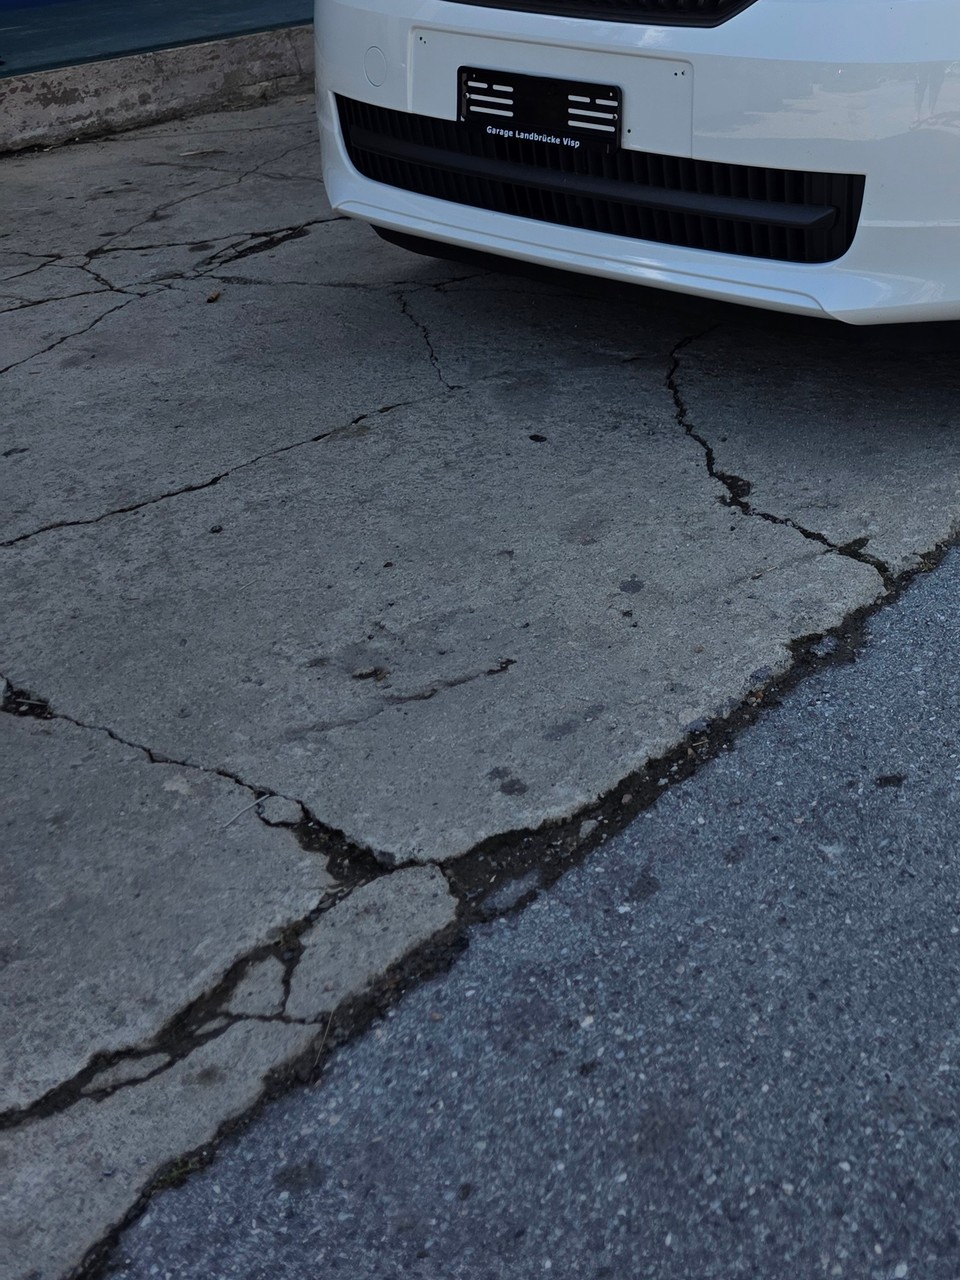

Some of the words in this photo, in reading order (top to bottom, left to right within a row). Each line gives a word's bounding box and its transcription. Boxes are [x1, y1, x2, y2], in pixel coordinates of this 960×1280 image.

[486, 125, 514, 138] Garage
[515, 129, 561, 146] Landbrücke
[562, 136, 580, 149] Visp
